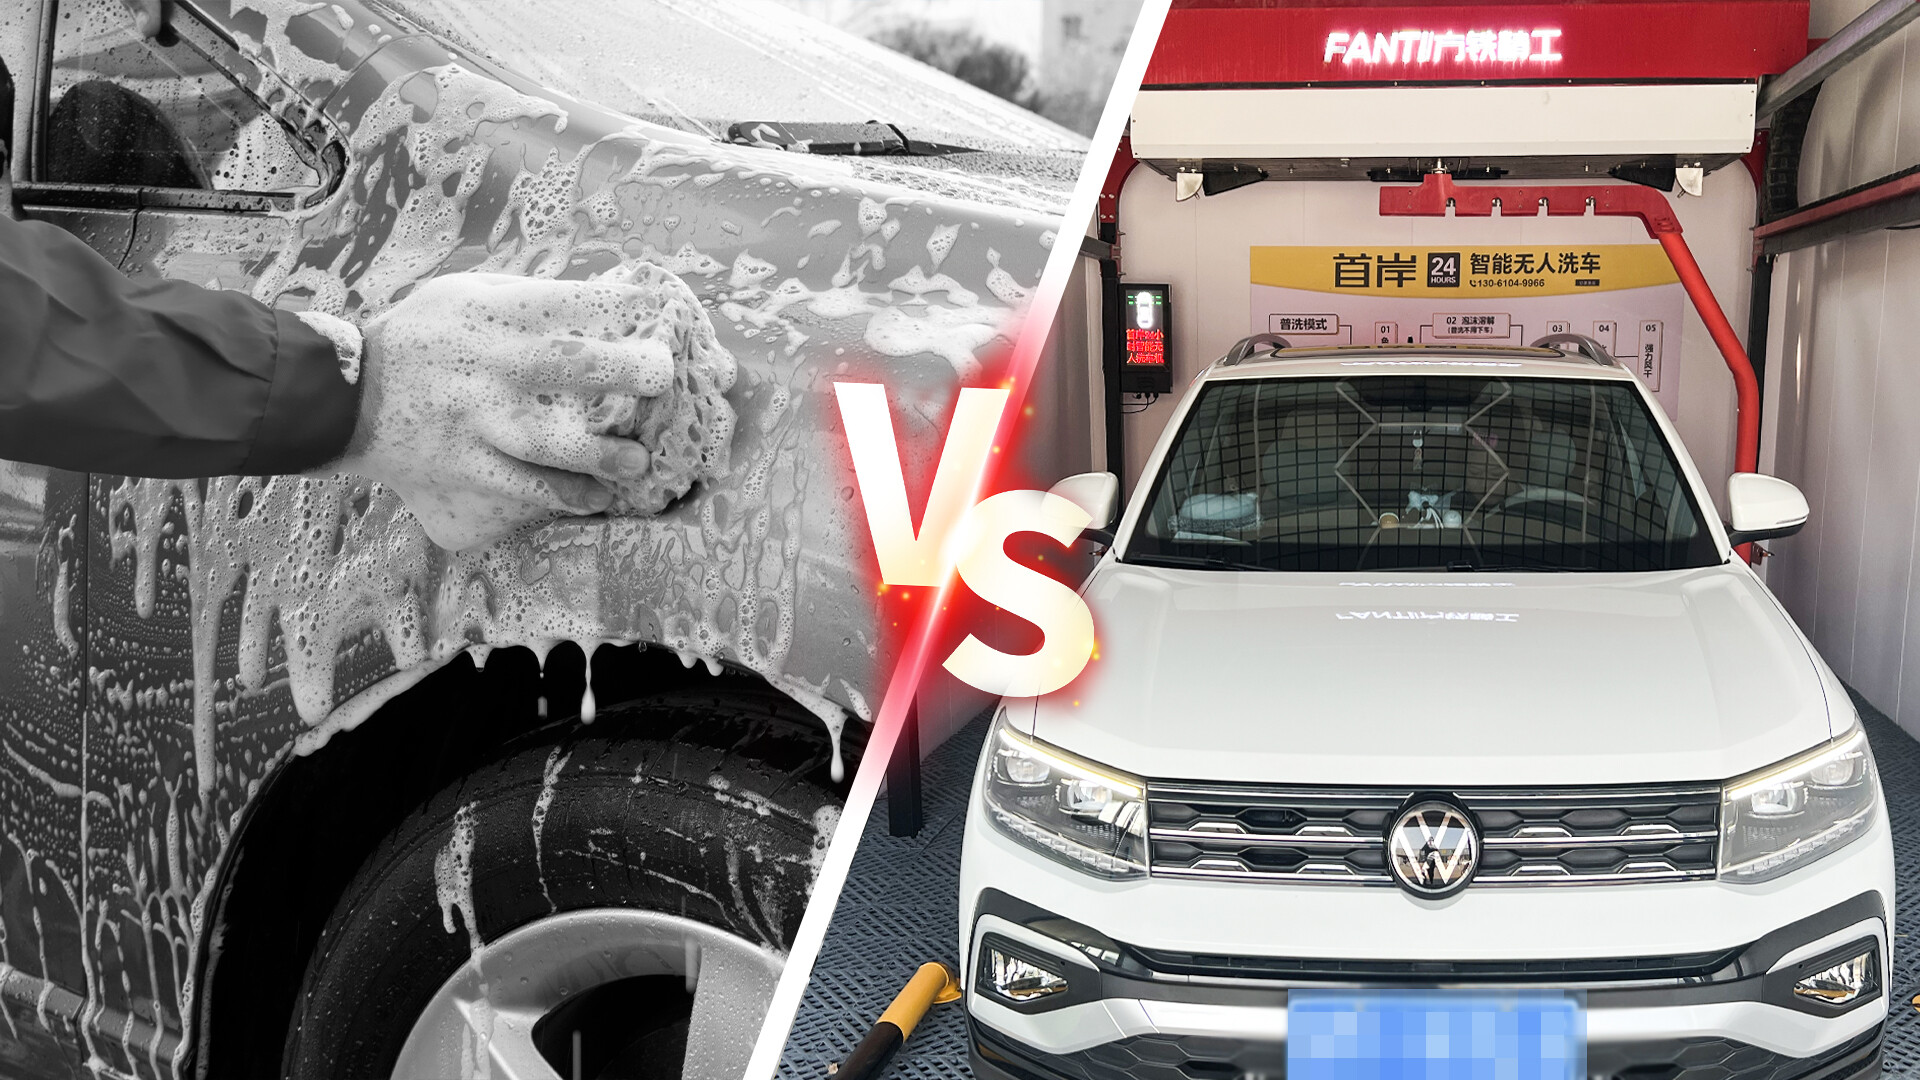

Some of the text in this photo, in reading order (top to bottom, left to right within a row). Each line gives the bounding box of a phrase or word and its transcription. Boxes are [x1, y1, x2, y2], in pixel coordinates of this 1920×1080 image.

[1431, 256, 1457, 276] 24
[1469, 252, 1600, 275] 智能无人洗车
[1333, 252, 1417, 288] 首岸
[1431, 276, 1457, 284] HOURS
[1477, 279, 1545, 288] 130-6104-9966
[1279, 317, 1328, 331] 普洗模式
[1446, 316, 1457, 325] 02
[1380, 325, 1390, 334] 01
[1552, 324, 1563, 332] 03
[1598, 324, 1610, 332] 04
[1645, 324, 1656, 332] 05
[1643, 344, 1654, 378] 强力风干
